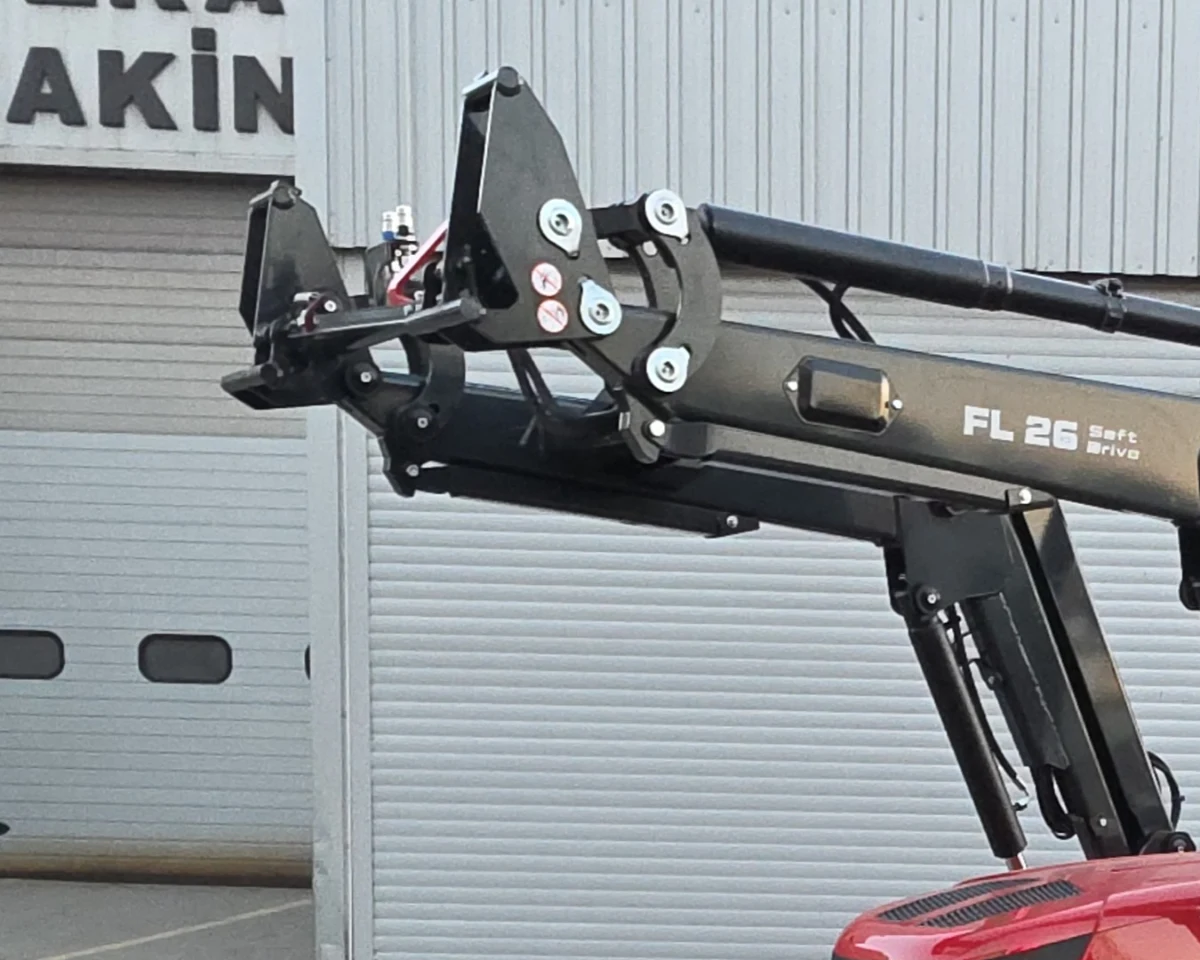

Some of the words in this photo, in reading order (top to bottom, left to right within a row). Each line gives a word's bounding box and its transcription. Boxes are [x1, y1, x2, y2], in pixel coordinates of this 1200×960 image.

[6, 26, 295, 135] AKİN
[963, 405, 1014, 442] FL
[1024, 415, 1078, 450] 26
[1088, 424, 1138, 444] Soft
[1086, 440, 1140, 460] Drive
